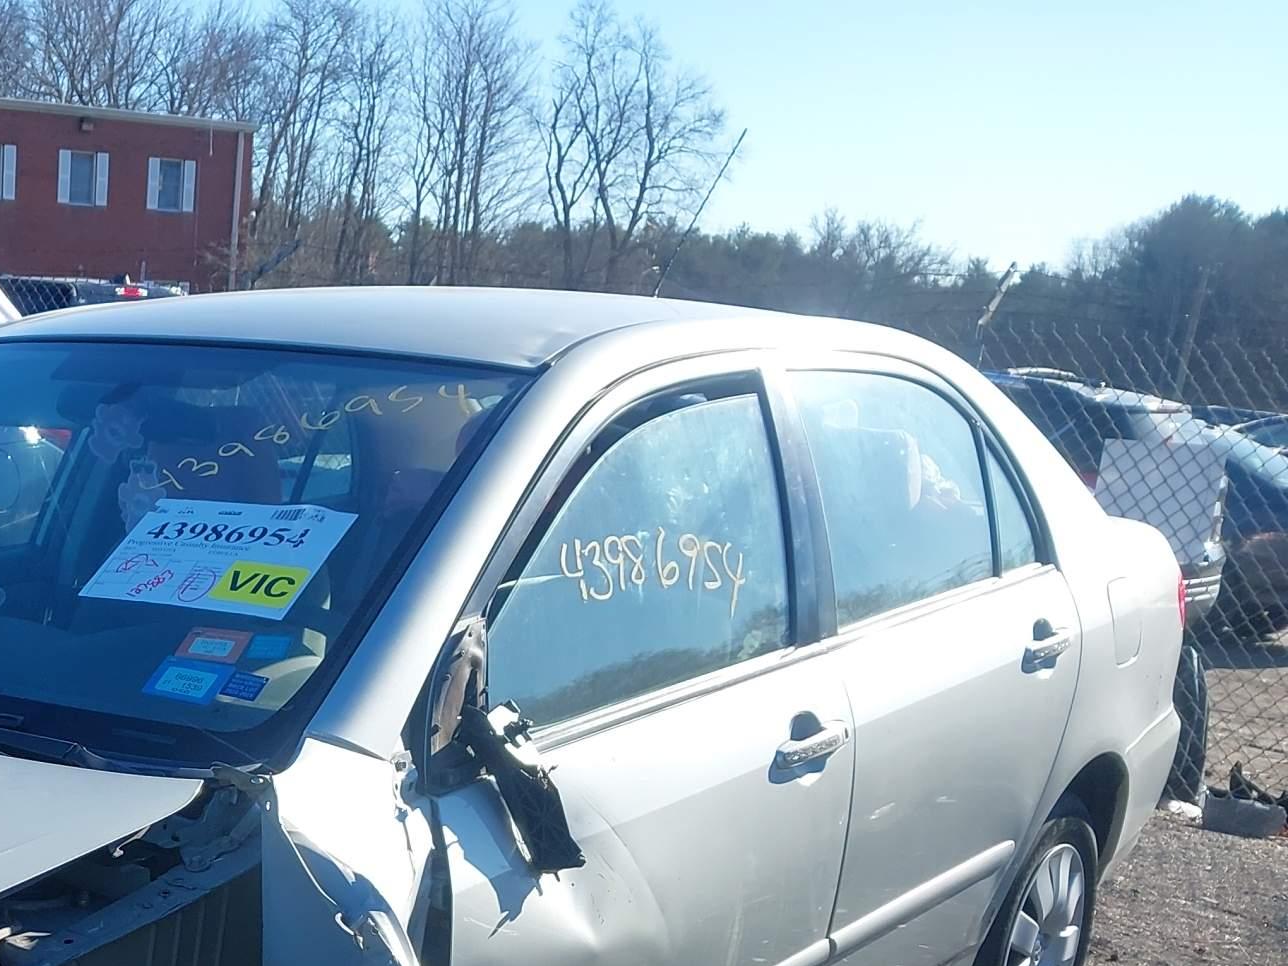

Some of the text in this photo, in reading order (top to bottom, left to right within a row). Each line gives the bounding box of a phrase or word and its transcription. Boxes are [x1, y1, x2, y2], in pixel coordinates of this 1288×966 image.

[147, 521, 312, 548] 43986954
[228, 570, 296, 598] VIC
[560, 526, 746, 619] 43986954
